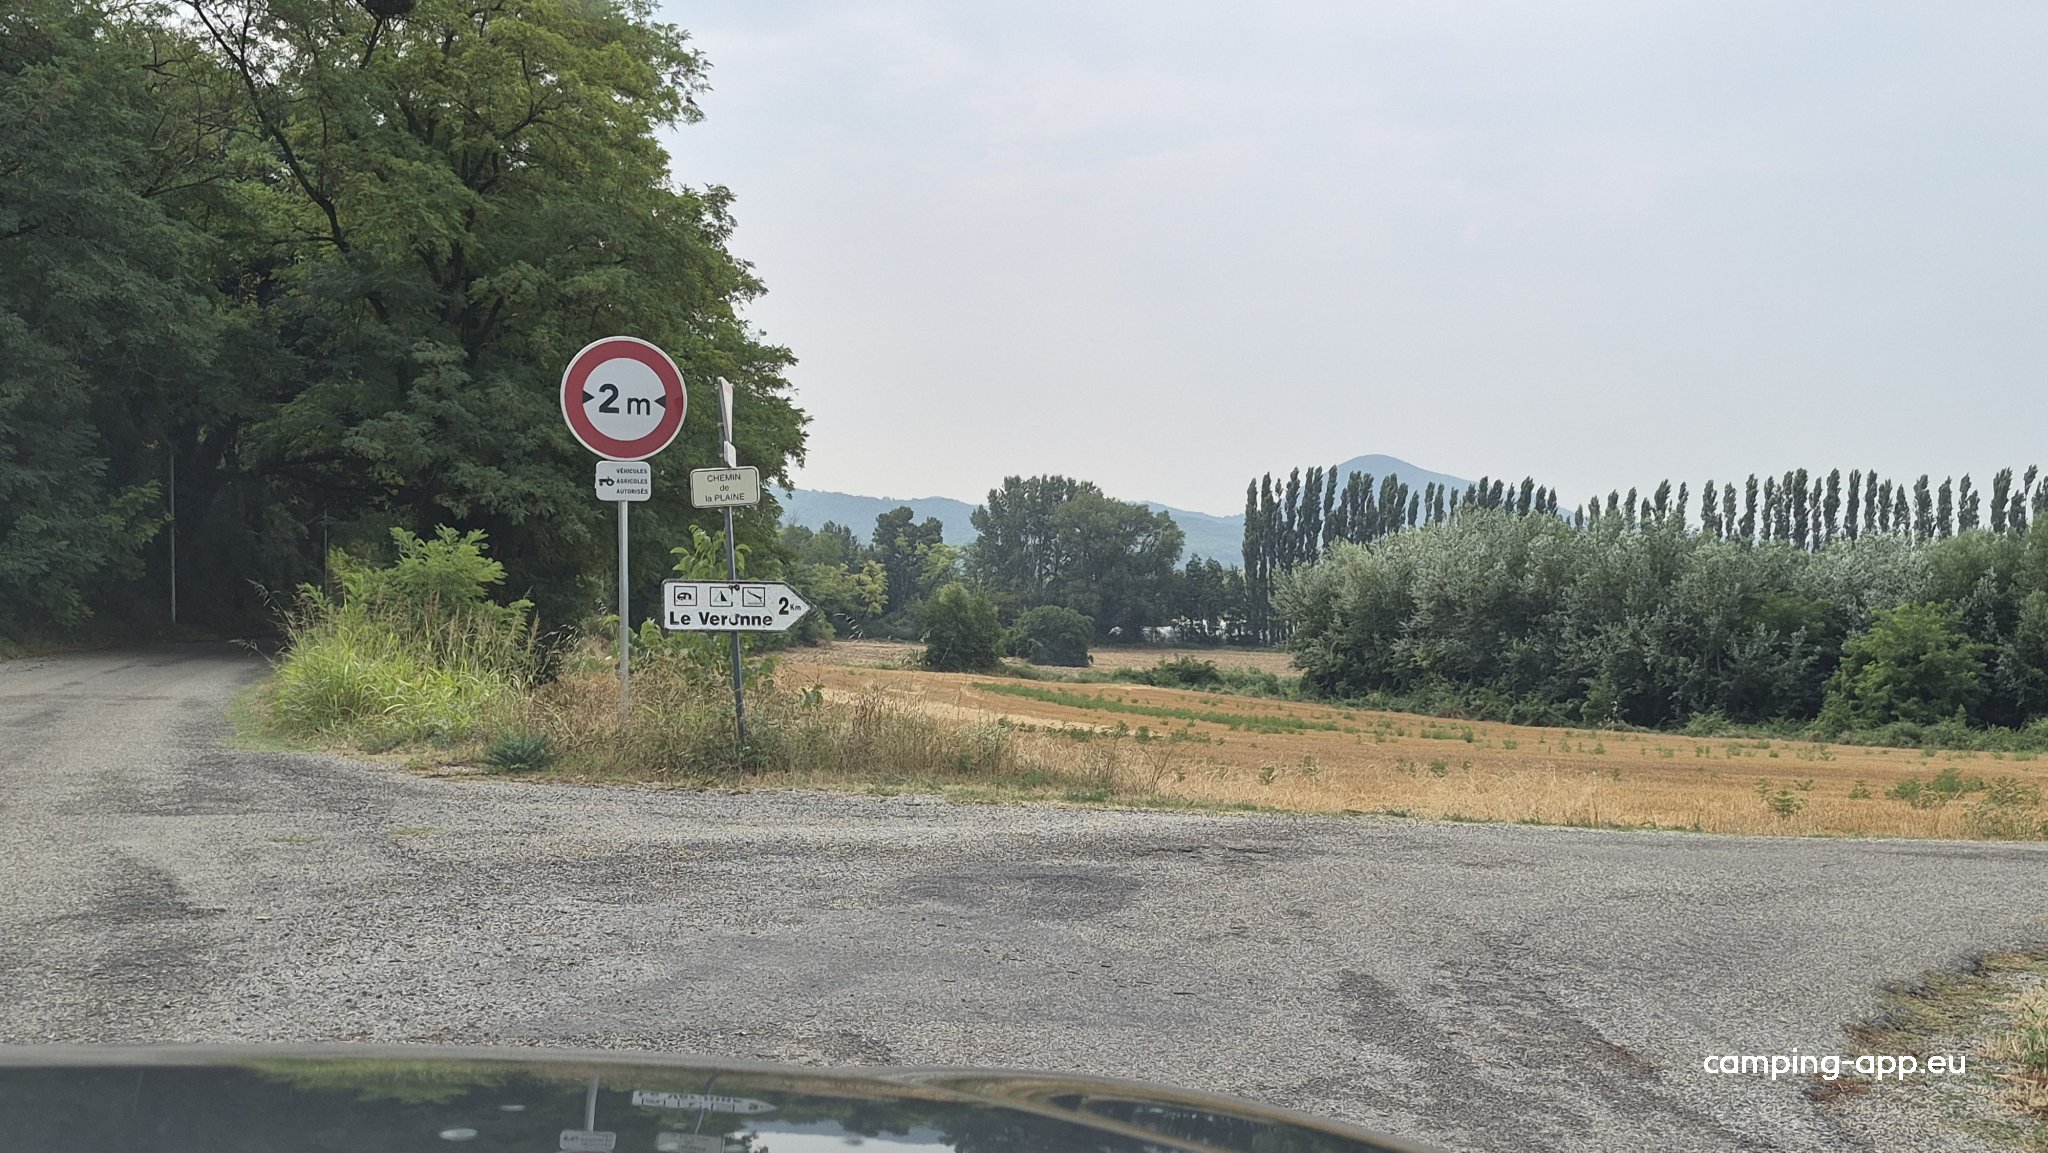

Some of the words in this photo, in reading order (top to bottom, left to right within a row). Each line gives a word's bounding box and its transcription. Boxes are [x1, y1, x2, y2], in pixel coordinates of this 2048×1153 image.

[598, 383, 620, 414] 2
[627, 397, 651, 416] m
[616, 467, 648, 475] VÉHICULES
[707, 473, 741, 483] CHEMIN
[719, 484, 730, 492] de
[705, 495, 712, 503] la
[715, 493, 745, 502] PLAINE
[778, 597, 789, 615] 2
[670, 611, 691, 625] Le
